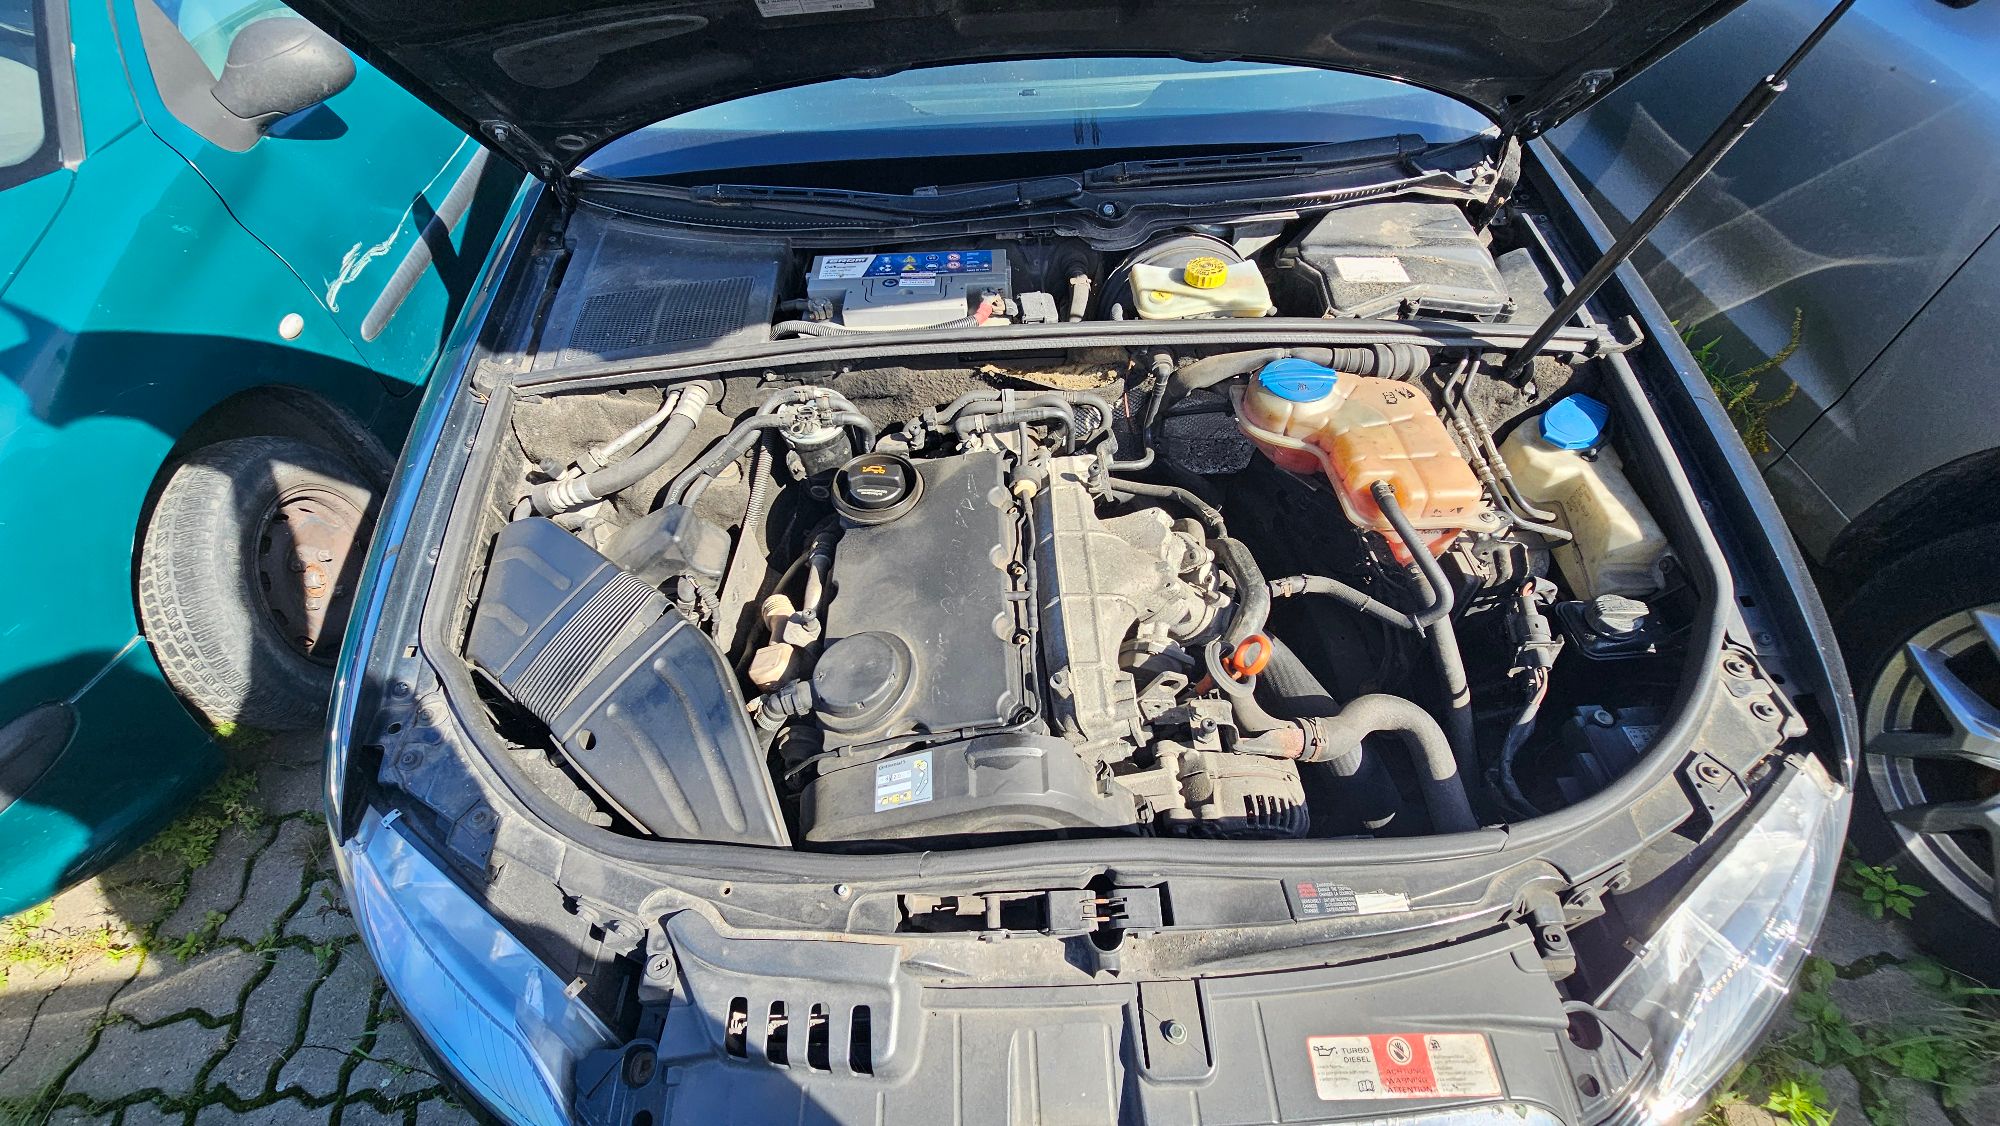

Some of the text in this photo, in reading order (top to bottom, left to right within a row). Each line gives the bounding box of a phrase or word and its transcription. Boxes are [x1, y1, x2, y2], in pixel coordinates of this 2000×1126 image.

[1341, 1047, 1370, 1055] TURBO
[1386, 1077, 1428, 1085] WARNING
[1387, 1086, 1433, 1094] ATTENTION
